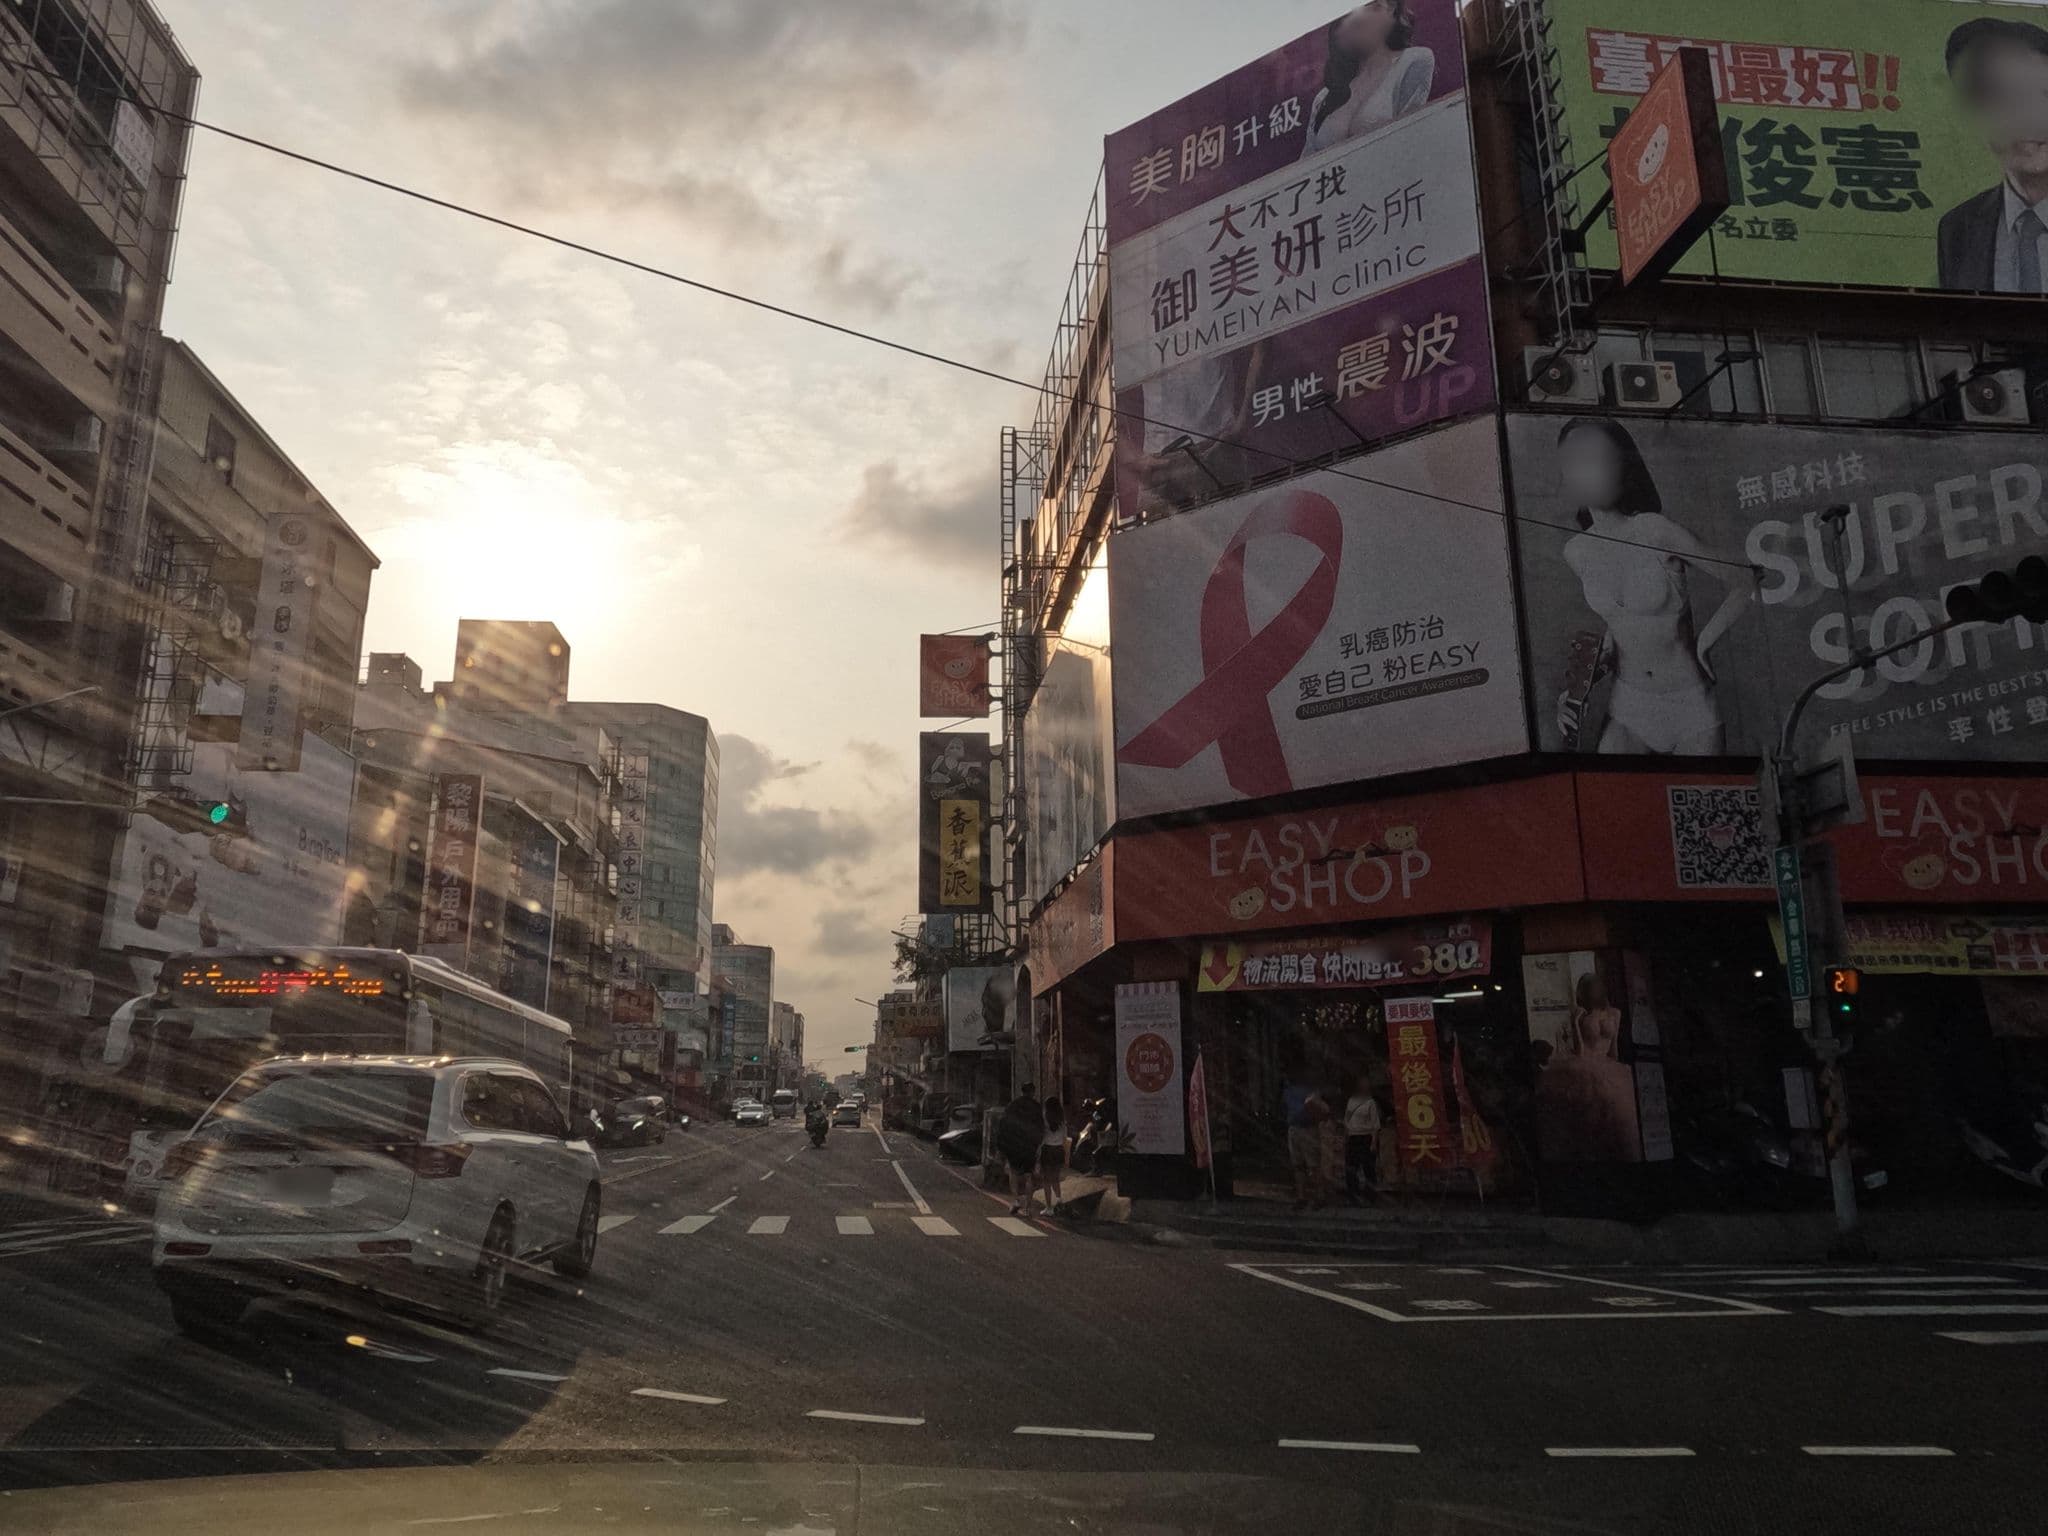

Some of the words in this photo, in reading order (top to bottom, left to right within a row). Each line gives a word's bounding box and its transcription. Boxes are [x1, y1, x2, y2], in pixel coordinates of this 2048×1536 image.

[1129, 97, 1302, 207] 美胸升級
[1600, 106, 1934, 213] 俊憲
[1208, 166, 1347, 253] 大不了找
[1151, 179, 1426, 333] 御美妍診所
[1155, 281, 1317, 363] YUMEIYAN
[1332, 243, 1427, 295] clinic
[1253, 312, 1460, 428] 男性震波
[1736, 452, 1866, 508] 無感科技
[1745, 463, 2048, 604] SUPER
[1298, 664, 1374, 701] 愛自己
[1383, 641, 1481, 683] 粉EASY
[1339, 614, 1445, 660] 乳癌防治
[1302, 699, 1344, 716] National
[1347, 691, 1380, 708] Breast
[1381, 685, 1419, 700] Cancer
[1421, 673, 1481, 693] Awareness
[1830, 716, 1871, 738] FREE
[1877, 702, 1926, 728] STYLE
[1931, 695, 1947, 712] IS
[1952, 687, 1984, 707] THE
[1988, 675, 2028, 697] BEST
[1209, 818, 1339, 877] EASY
[1872, 788, 2020, 838] EASY
[944, 807, 974, 897] 香蕉派
[1269, 847, 1432, 913] SHOP
[1242, 950, 1317, 985] 物流開倉
[1399, 1024, 1444, 1164] 最後6天
